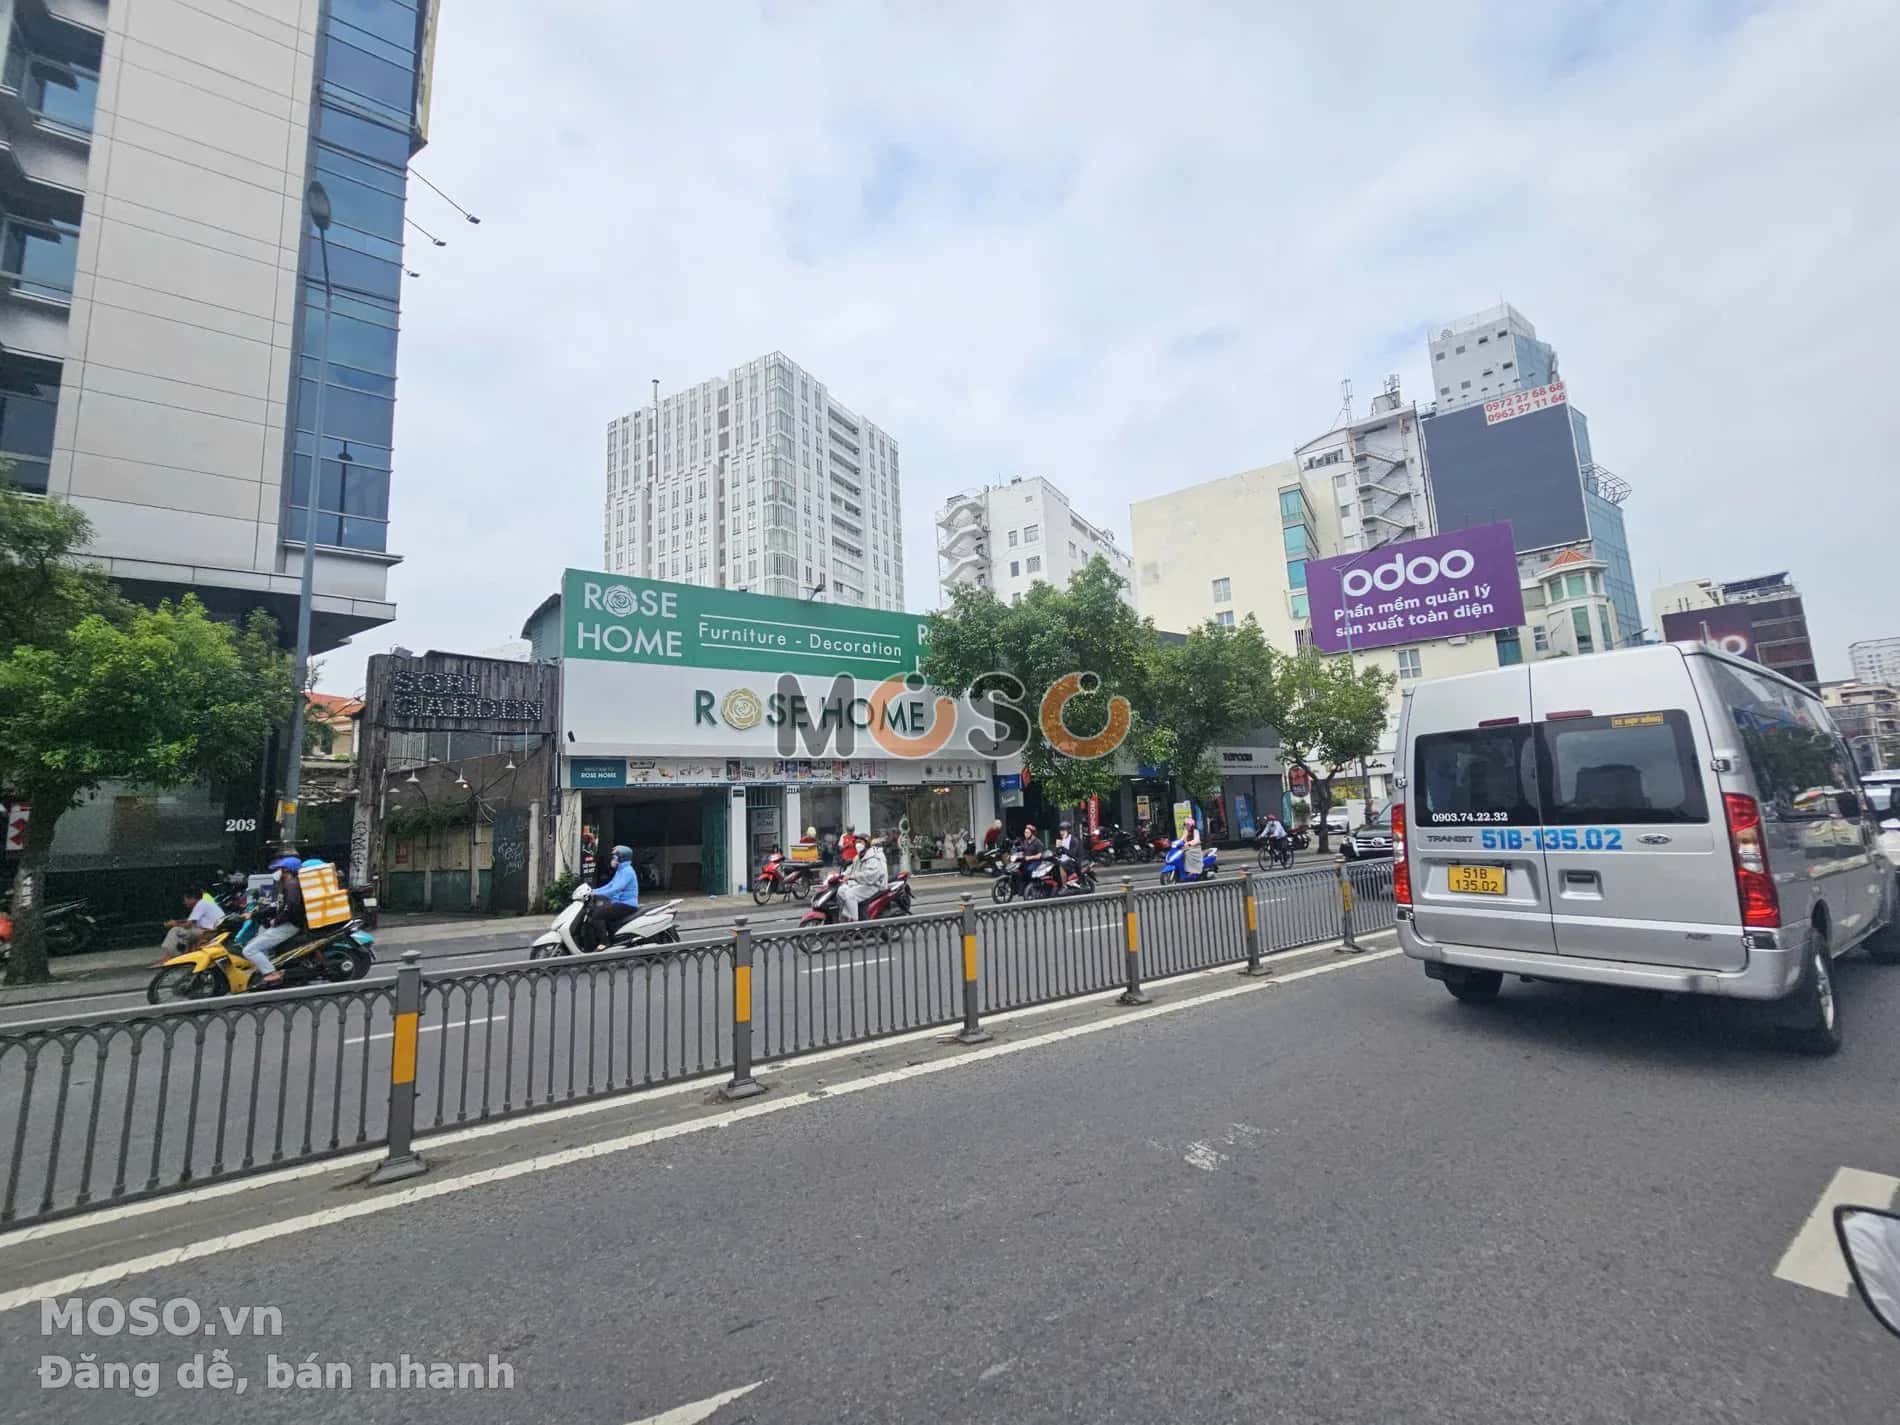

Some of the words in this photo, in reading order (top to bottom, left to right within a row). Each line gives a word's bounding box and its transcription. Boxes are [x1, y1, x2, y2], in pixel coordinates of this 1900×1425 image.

[1486, 398, 1512, 412] 0972
[1515, 393, 1529, 403] 27
[1532, 387, 1547, 398] 68
[1549, 381, 1564, 393] 68
[1518, 403, 1531, 414] 57
[1534, 397, 1548, 408] 11
[1551, 392, 1566, 403] 66
[1342, 549, 1475, 597] odoo
[583, 581, 678, 619] ROSE
[1378, 596, 1420, 615] mềm
[1425, 587, 1469, 606] quản
[1474, 583, 1492, 600] lý
[1367, 614, 1404, 633] xuất
[1408, 610, 1448, 627] toàn
[1453, 602, 1494, 618] diện
[577, 622, 682, 658] HOME
[698, 622, 787, 647] Furniture
[809, 633, 902, 657] Decoration
[393, 671, 481, 698] SORI
[393, 696, 544, 721] GARDEN
[694, 688, 808, 730] ROSE
[821, 696, 925, 732] HOME
[225, 818, 257, 832] 203
[1432, 811, 1508, 823] 0903.74.22.32
[1426, 835, 1474, 843] TRANSIT
[1480, 827, 1624, 851] 51B-135.02
[1454, 878, 1499, 893] 135.02
[1463, 867, 1488, 880] 51B
